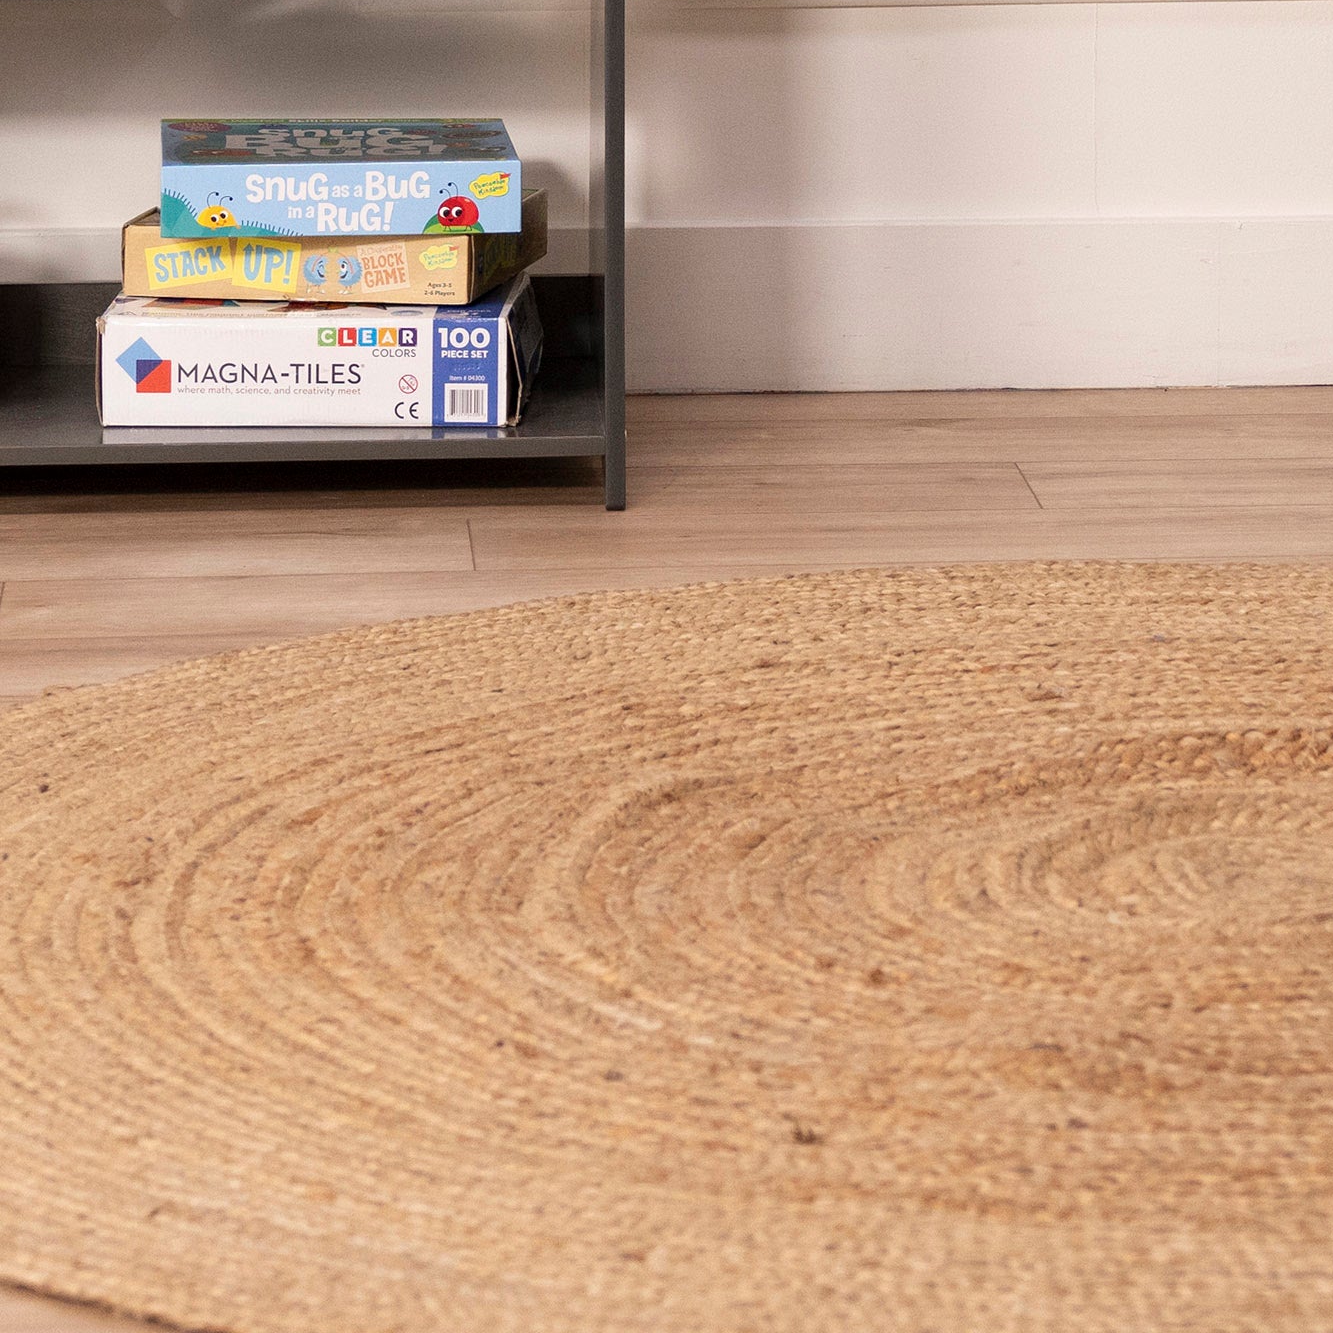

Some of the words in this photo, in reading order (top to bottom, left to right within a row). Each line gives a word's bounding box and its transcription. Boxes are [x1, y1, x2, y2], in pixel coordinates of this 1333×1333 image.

[332, 185, 349, 198] as
[353, 185, 363, 198] a
[288, 206, 302, 219] in
[306, 206, 315, 219] a
[153, 245, 226, 282] STACK
[243, 243, 294, 284] UP!
[361, 253, 404, 270] BLOCK
[364, 267, 406, 288] GAME
[320, 329, 415, 344] CLEAR
[438, 327, 491, 349] 100
[372, 348, 417, 358] COLORS
[441, 350, 469, 359] PIECE
[470, 350, 488, 359] SET
[177, 385, 205, 395] where
[208, 385, 233, 395] math,
[235, 385, 272, 395] science,
[274, 386, 291, 395] and
[293, 386, 335, 396] creativity
[338, 387, 361, 396] meet
